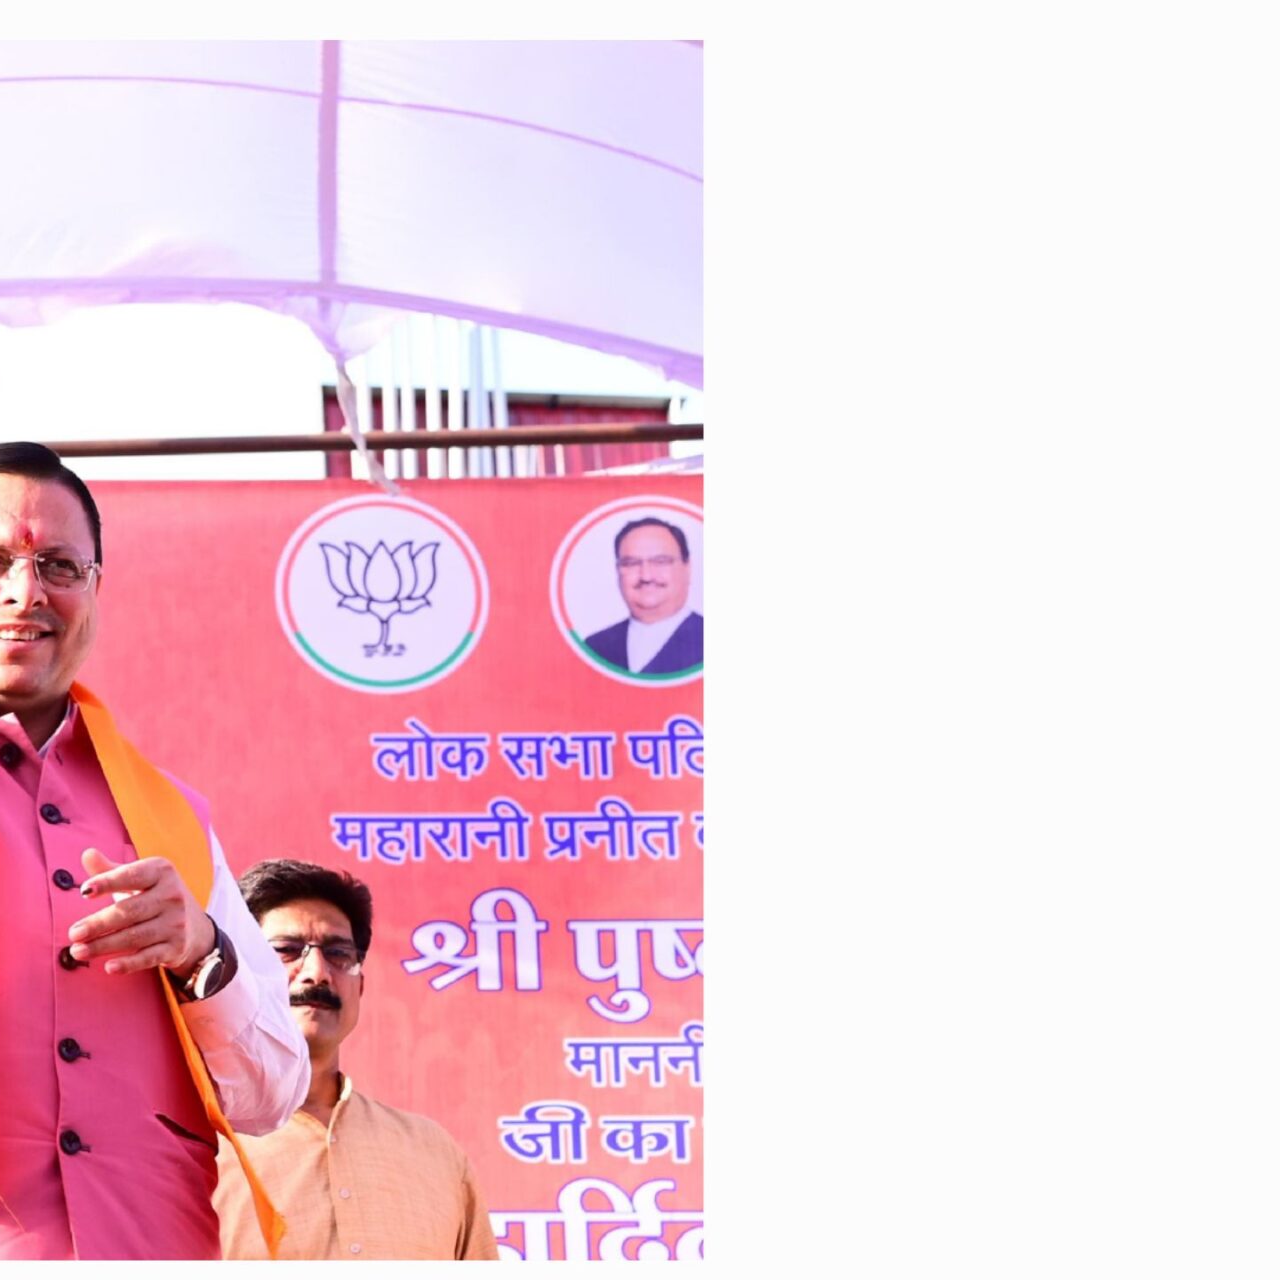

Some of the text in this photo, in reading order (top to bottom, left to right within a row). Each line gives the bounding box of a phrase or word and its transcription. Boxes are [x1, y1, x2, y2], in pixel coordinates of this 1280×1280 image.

[373, 720, 486, 778] लोक
[502, 736, 612, 777] सभा
[333, 800, 529, 861] महारानी
[545, 800, 679, 860] प्रनीत
[402, 887, 549, 992] श्री
[501, 1104, 691, 1161] जी का
